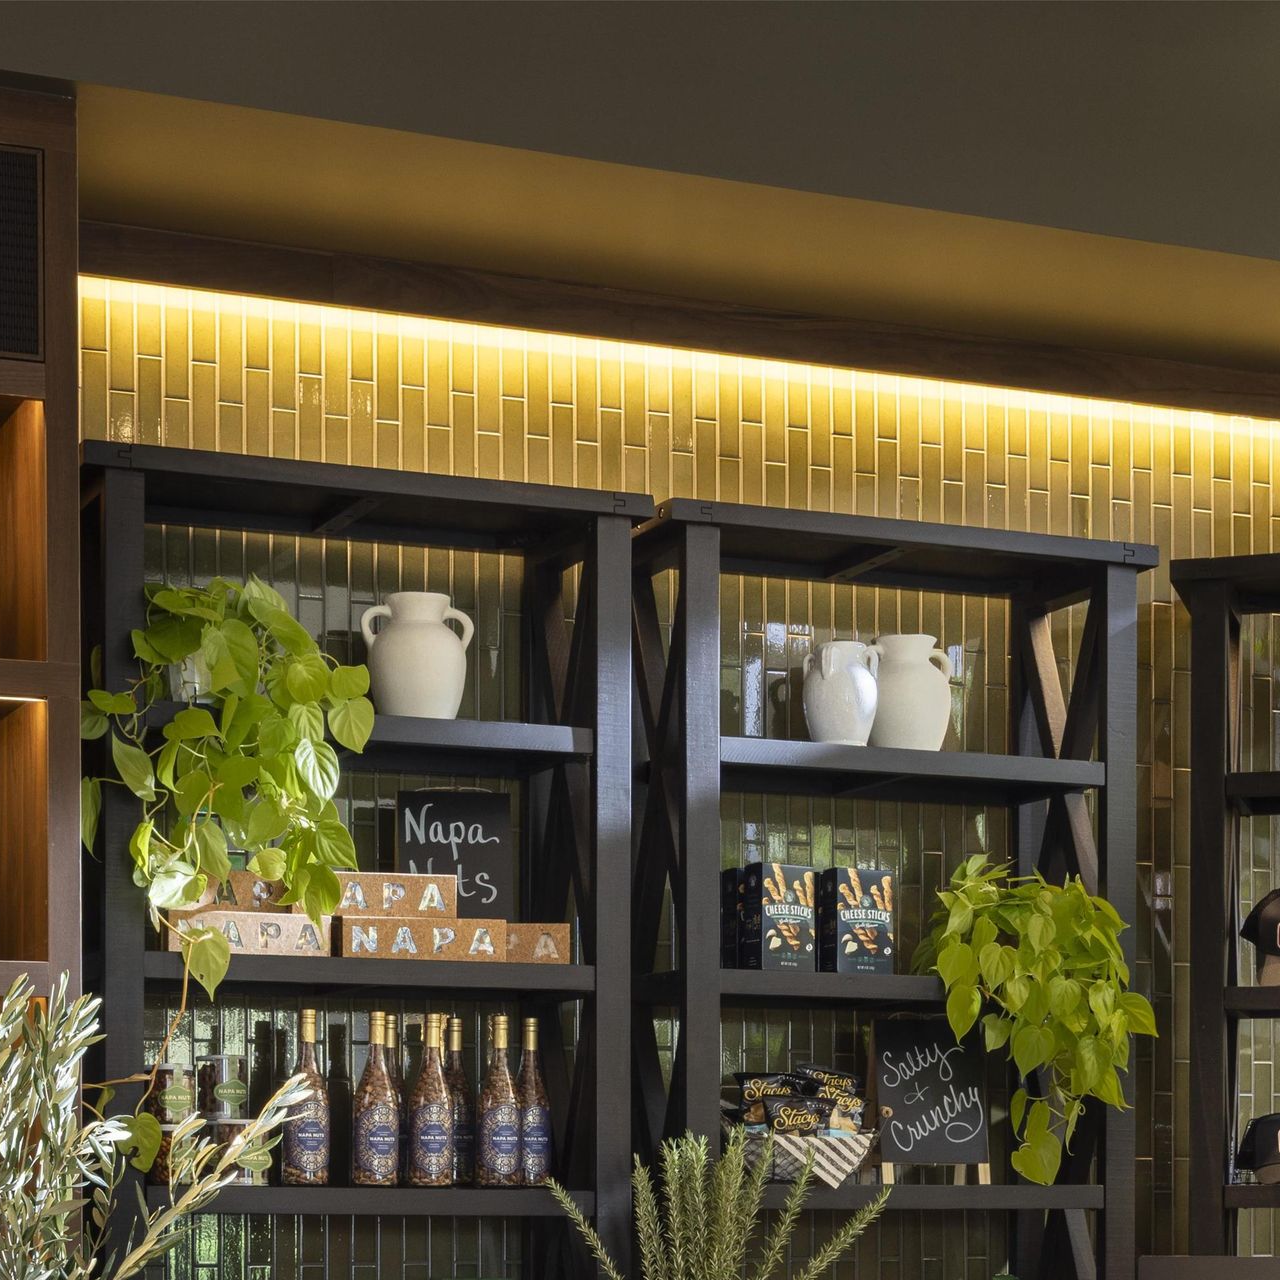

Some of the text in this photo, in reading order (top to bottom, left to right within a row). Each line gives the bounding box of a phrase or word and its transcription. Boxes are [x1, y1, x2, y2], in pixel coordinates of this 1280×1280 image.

[404, 803, 500, 859] Napa
[766, 905, 812, 919] CHEESE STICKS
[841, 910, 890, 923] CHEESE STICKS
[351, 925, 494, 955] NAPA
[883, 1043, 964, 1087] Salty
[891, 1085, 983, 1151] Crunchy
